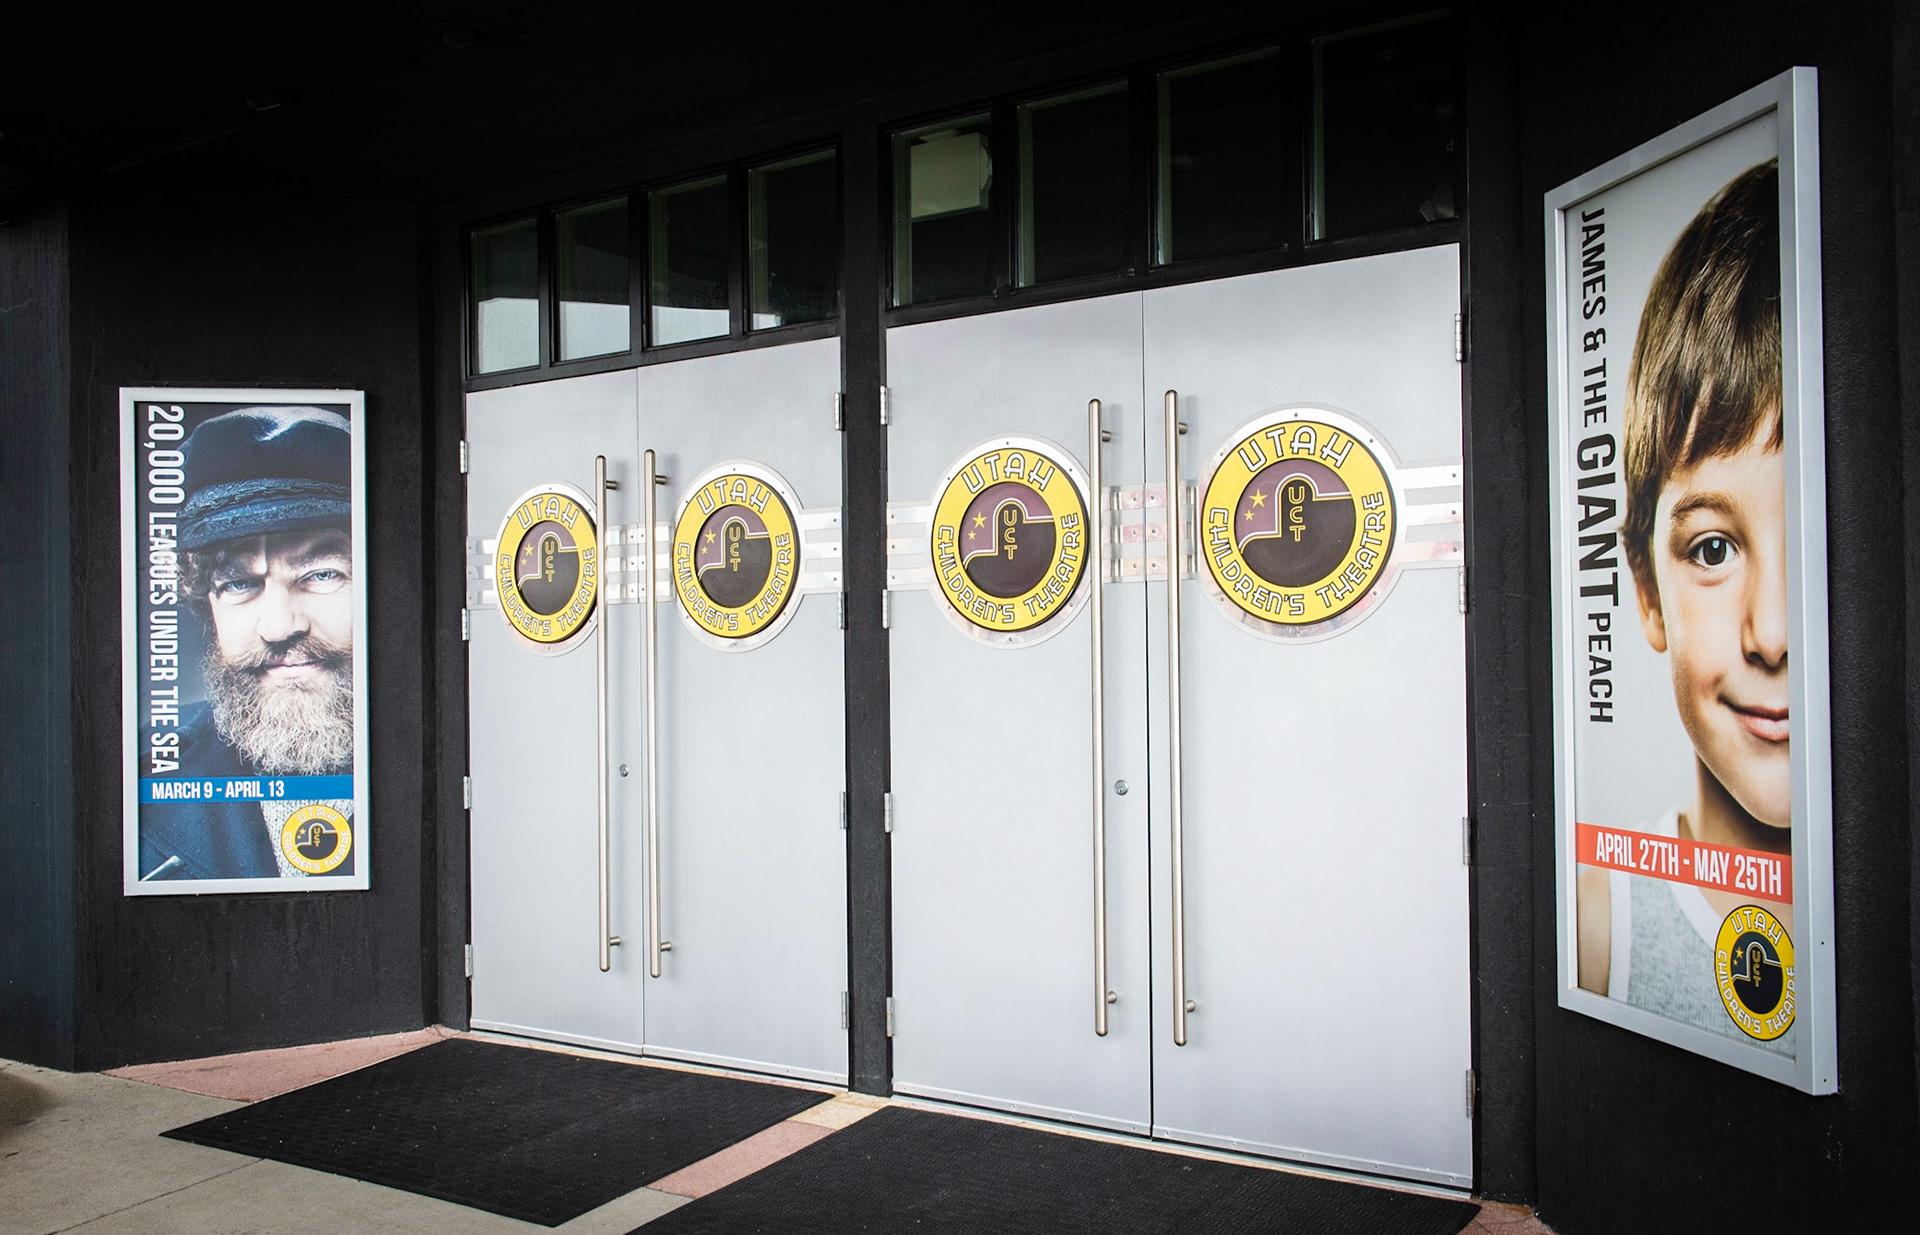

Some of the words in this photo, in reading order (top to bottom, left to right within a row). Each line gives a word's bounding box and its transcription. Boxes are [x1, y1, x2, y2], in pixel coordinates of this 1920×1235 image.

[1581, 208, 1606, 321] JAMES
[1582, 328, 1607, 352] &
[1582, 359, 1607, 429] THE
[143, 405, 186, 505] 20,000
[961, 452, 1056, 495] UTAH
[1237, 425, 1353, 473] UTAH
[516, 497, 580, 530] UTAH
[696, 478, 771, 515] UTAH
[1288, 486, 1304, 542] UCT
[1576, 433, 1619, 607] GIANT
[148, 511, 178, 606] LEAGUES
[729, 526, 741, 572] UCT
[1003, 508, 1017, 561] UCT
[1208, 506, 1305, 616] CHILDREN'S
[1315, 491, 1384, 609] THEATRE
[545, 540, 555, 583] UCT
[677, 542, 738, 631] CHILDREN'S
[745, 532, 791, 626] THEATRE
[937, 524, 1015, 624] CHILDREN'S
[1024, 511, 1081, 618] THEATRE
[501, 554, 551, 637] CHILDREN'S
[557, 547, 595, 633] THEATRE
[150, 610, 179, 682] UNDER
[1587, 612, 1613, 724] PEACH
[150, 686, 179, 728] THE
[151, 732, 180, 774] SEA
[152, 781, 201, 800] MARCH
[203, 781, 214, 799] 9
[225, 780, 264, 798] APRIL
[268, 780, 285, 797] 13
[296, 807, 339, 822] UTAH
[324, 830, 349, 868] THEATRE
[1596, 831, 1637, 870] APRIL
[1639, 838, 1679, 877] 27TH
[1694, 847, 1731, 886] MAY
[1735, 854, 1782, 896] 25TH
[1730, 909, 1782, 945] UTAH
[1718, 949, 1761, 1034] CHILDREN'S
[1752, 949, 1761, 988] UCT
